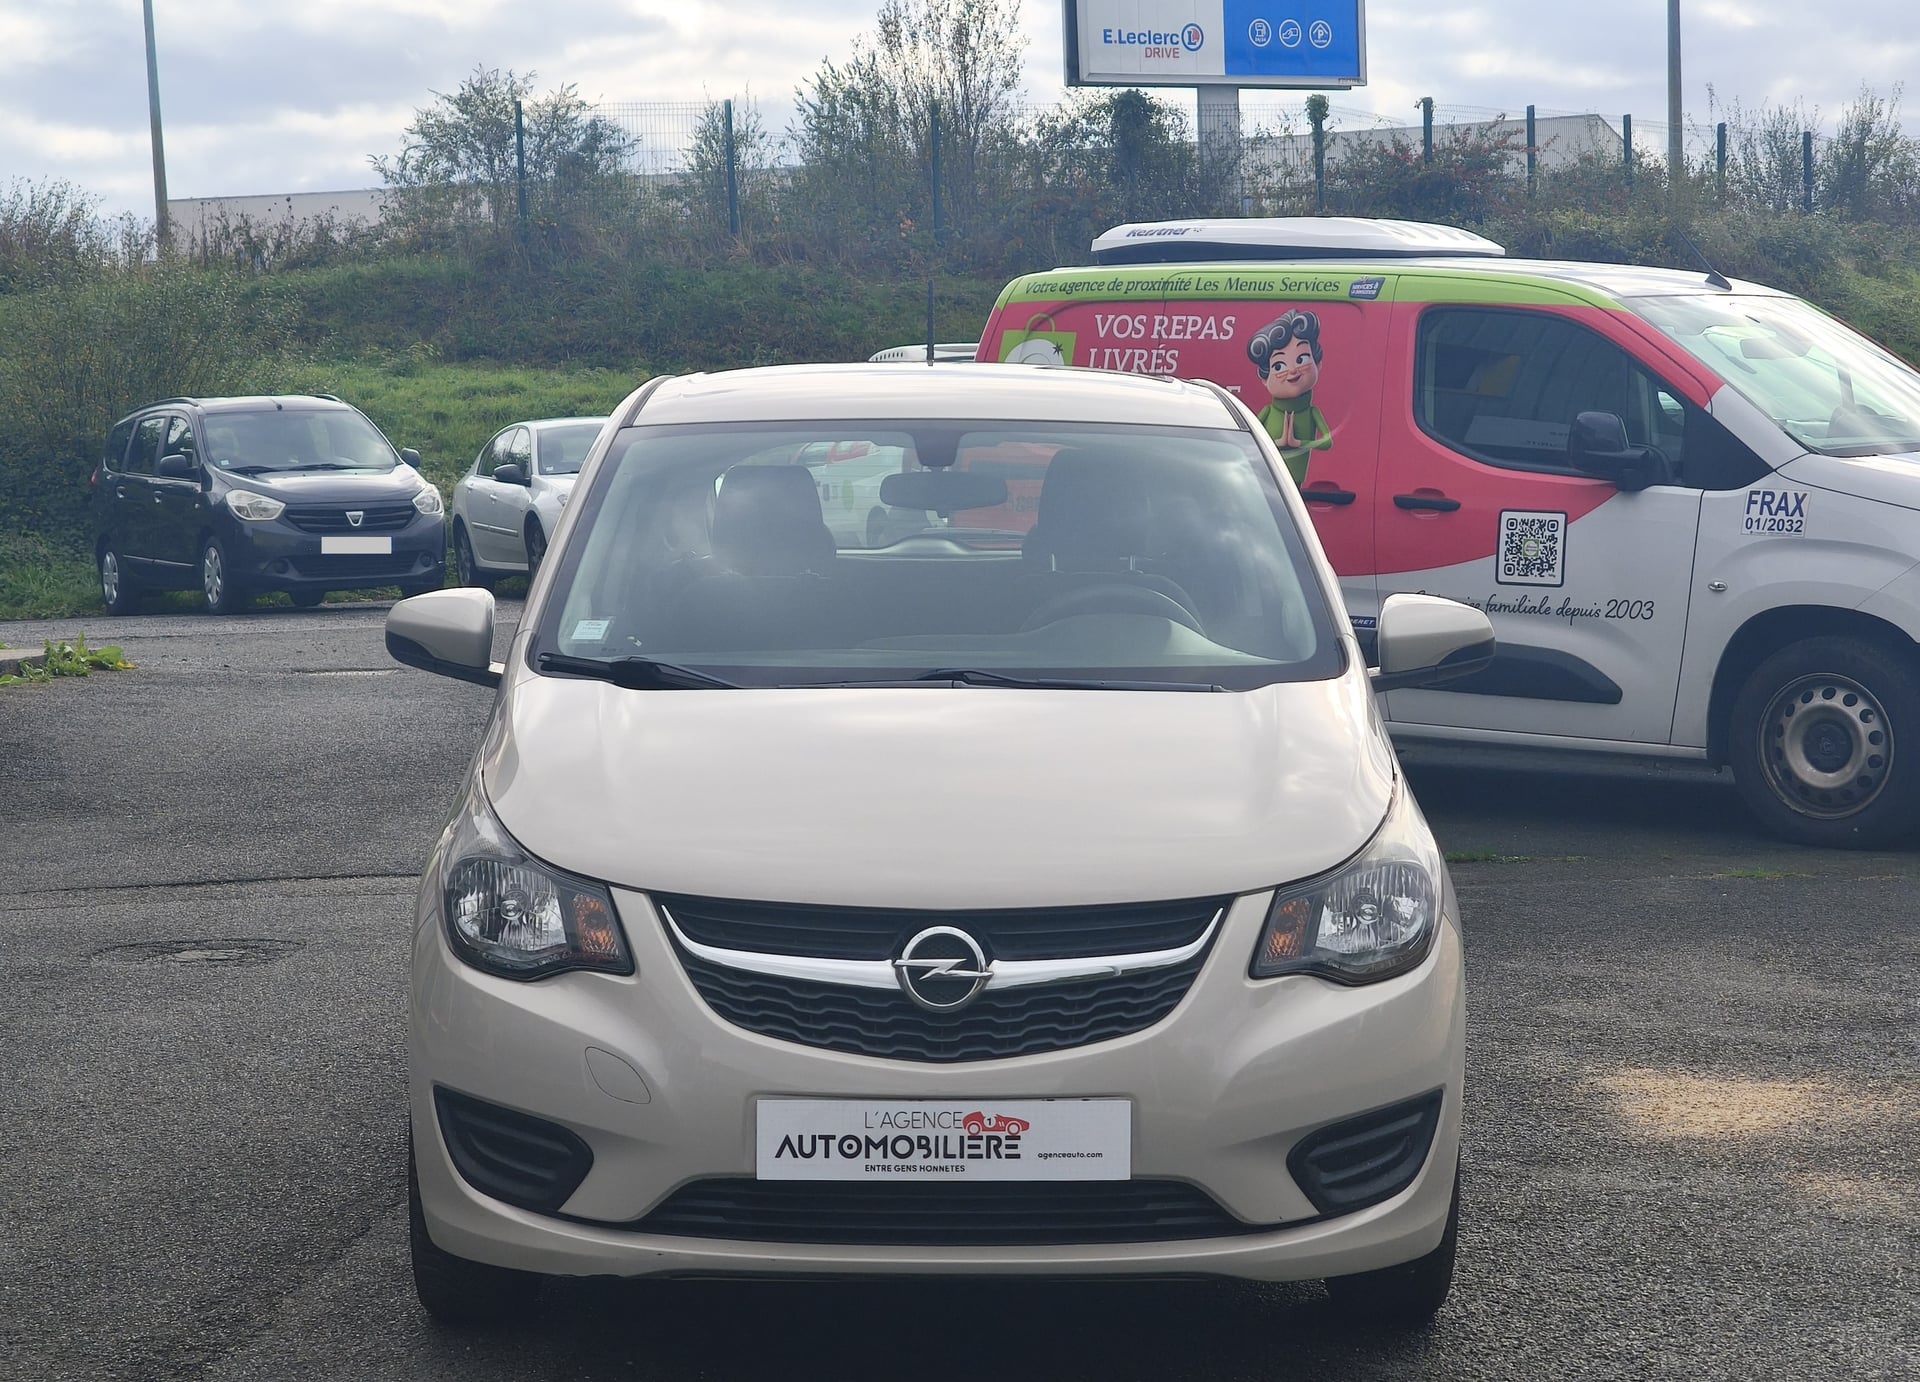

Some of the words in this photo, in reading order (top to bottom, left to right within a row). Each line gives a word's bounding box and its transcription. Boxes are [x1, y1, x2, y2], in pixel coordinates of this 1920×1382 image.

[1103, 28, 1180, 45] E.Leclerc
[1145, 47, 1180, 58] DRIVE
[1025, 282, 1058, 294] Votre
[1059, 281, 1105, 294] agence
[1106, 277, 1123, 292] de
[1124, 276, 1192, 294] proximité
[1195, 277, 1219, 291] Les
[1224, 277, 1274, 292] Menus
[1280, 276, 1340, 292] Services
[1095, 314, 1147, 339] VOS
[1151, 315, 1236, 340] REPAS
[1089, 344, 1179, 374] LIVRÉS
[1746, 490, 1808, 518] FRAX
[1745, 517, 1804, 533] 01/2032
[1483, 593, 1551, 615] familiale
[1555, 597, 1601, 626] depuis
[1605, 599, 1655, 620] 2003
[1037, 1152, 1103, 1160] agenceauto.com
[865, 1164, 892, 1172] ENTRE
[893, 1164, 918, 1172] GENS
